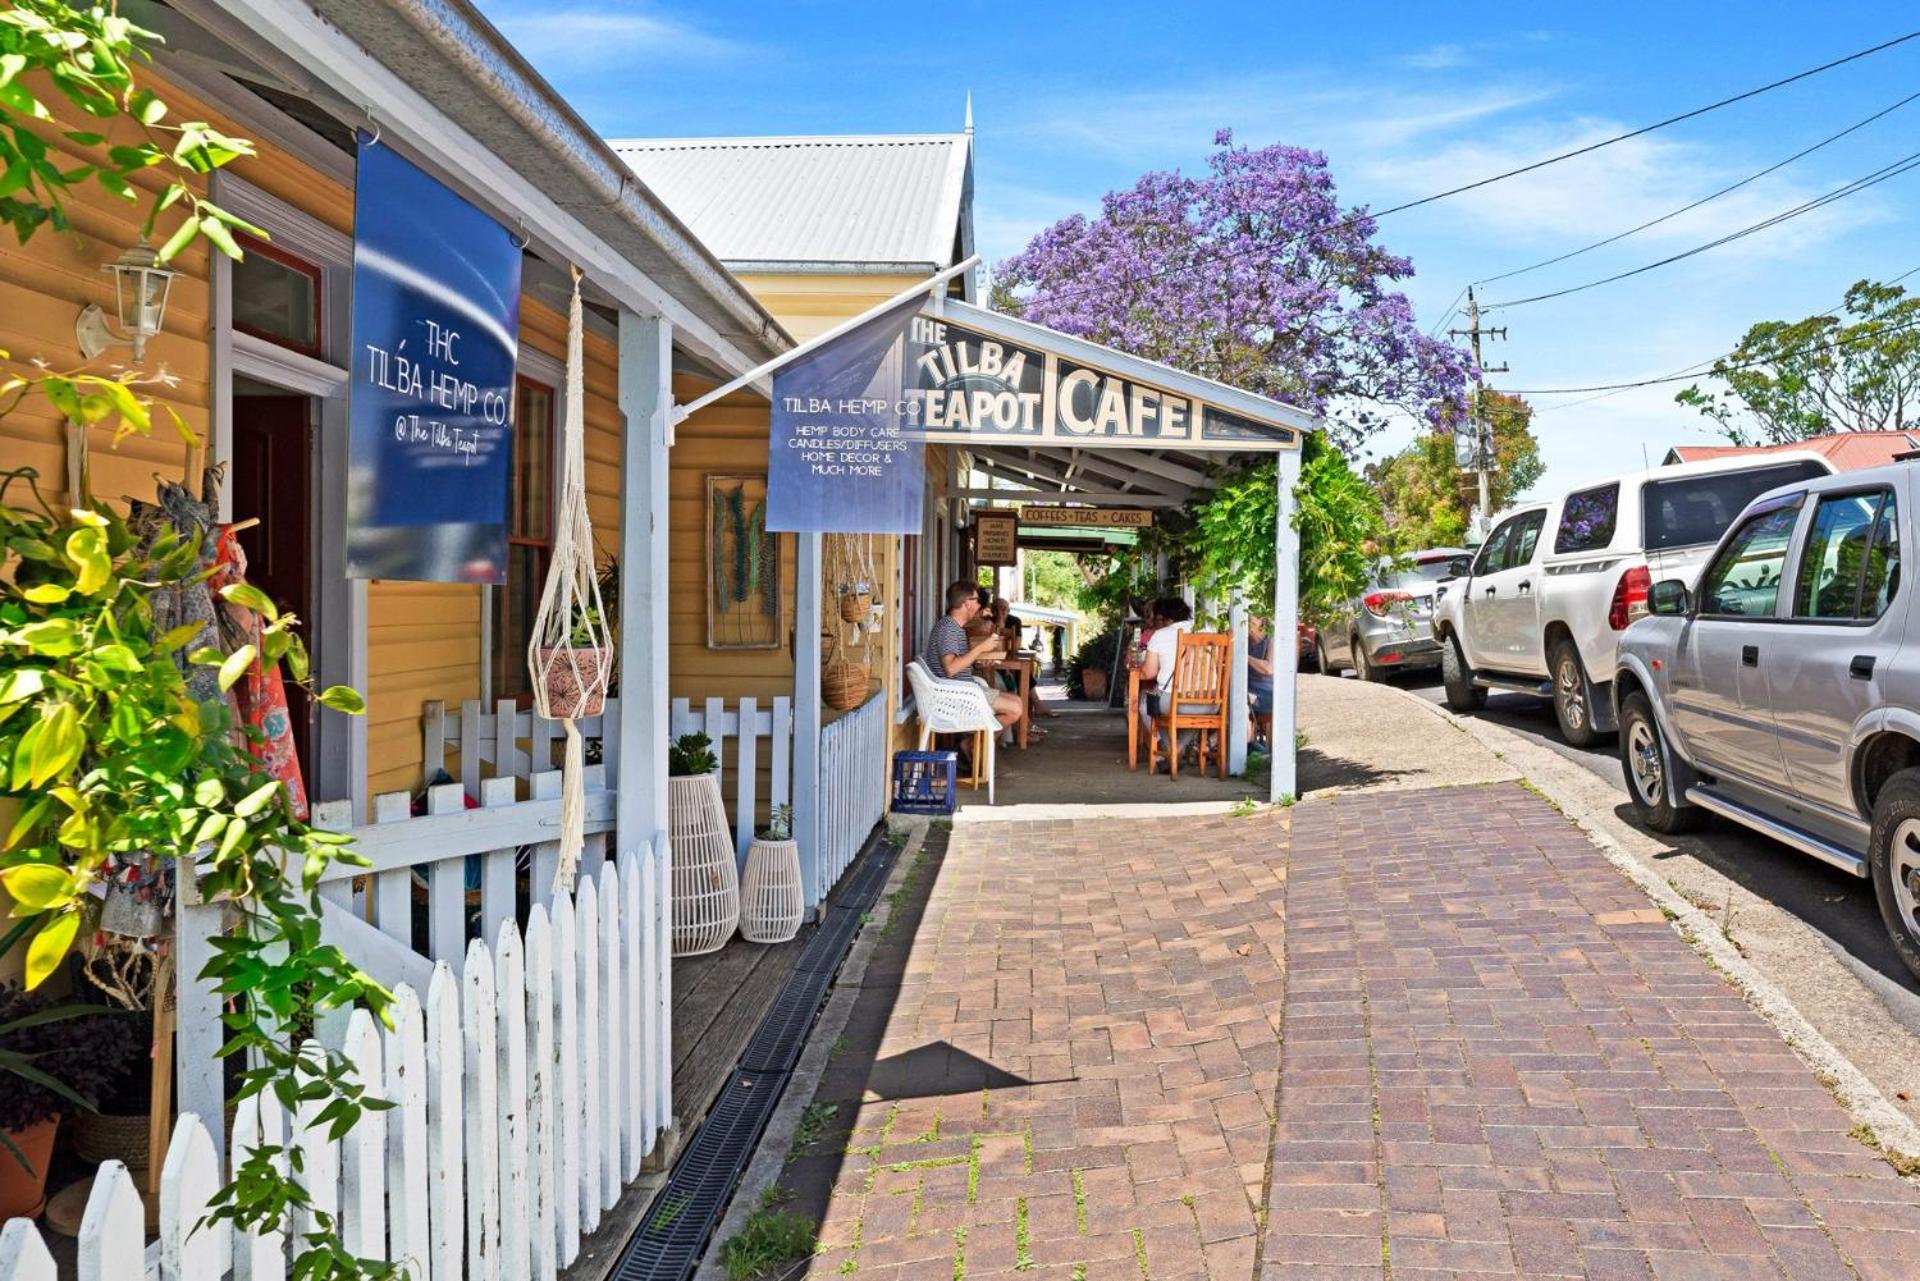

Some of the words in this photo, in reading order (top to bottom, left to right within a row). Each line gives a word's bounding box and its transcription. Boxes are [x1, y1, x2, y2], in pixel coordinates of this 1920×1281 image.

[425, 320, 460, 365] THC
[911, 317, 947, 345] THE
[916, 340, 1026, 389] TILBA
[430, 370, 478, 415] HEMP
[783, 397, 832, 413] TILBA
[839, 399, 888, 415] HEMP
[903, 388, 1042, 431] TEAPOT
[1058, 369, 1188, 438] CAFE
[395, 415, 407, 440] @
[408, 414, 428, 443] The
[430, 421, 453, 448] Tilba
[453, 428, 480, 467] Teapot
[795, 425, 827, 437] HEMP
[832, 427, 866, 437] BODY
[870, 427, 901, 438] CARE
[801, 451, 835, 462] HOME
[840, 452, 880, 463] DECOR
[884, 453, 892, 464] &
[811, 464, 845, 476] MUCH
[849, 465, 883, 477] MORE
[1025, 509, 1067, 523] COFFEES
[1073, 511, 1098, 523] TEAS
[1110, 511, 1142, 524] CAKES
